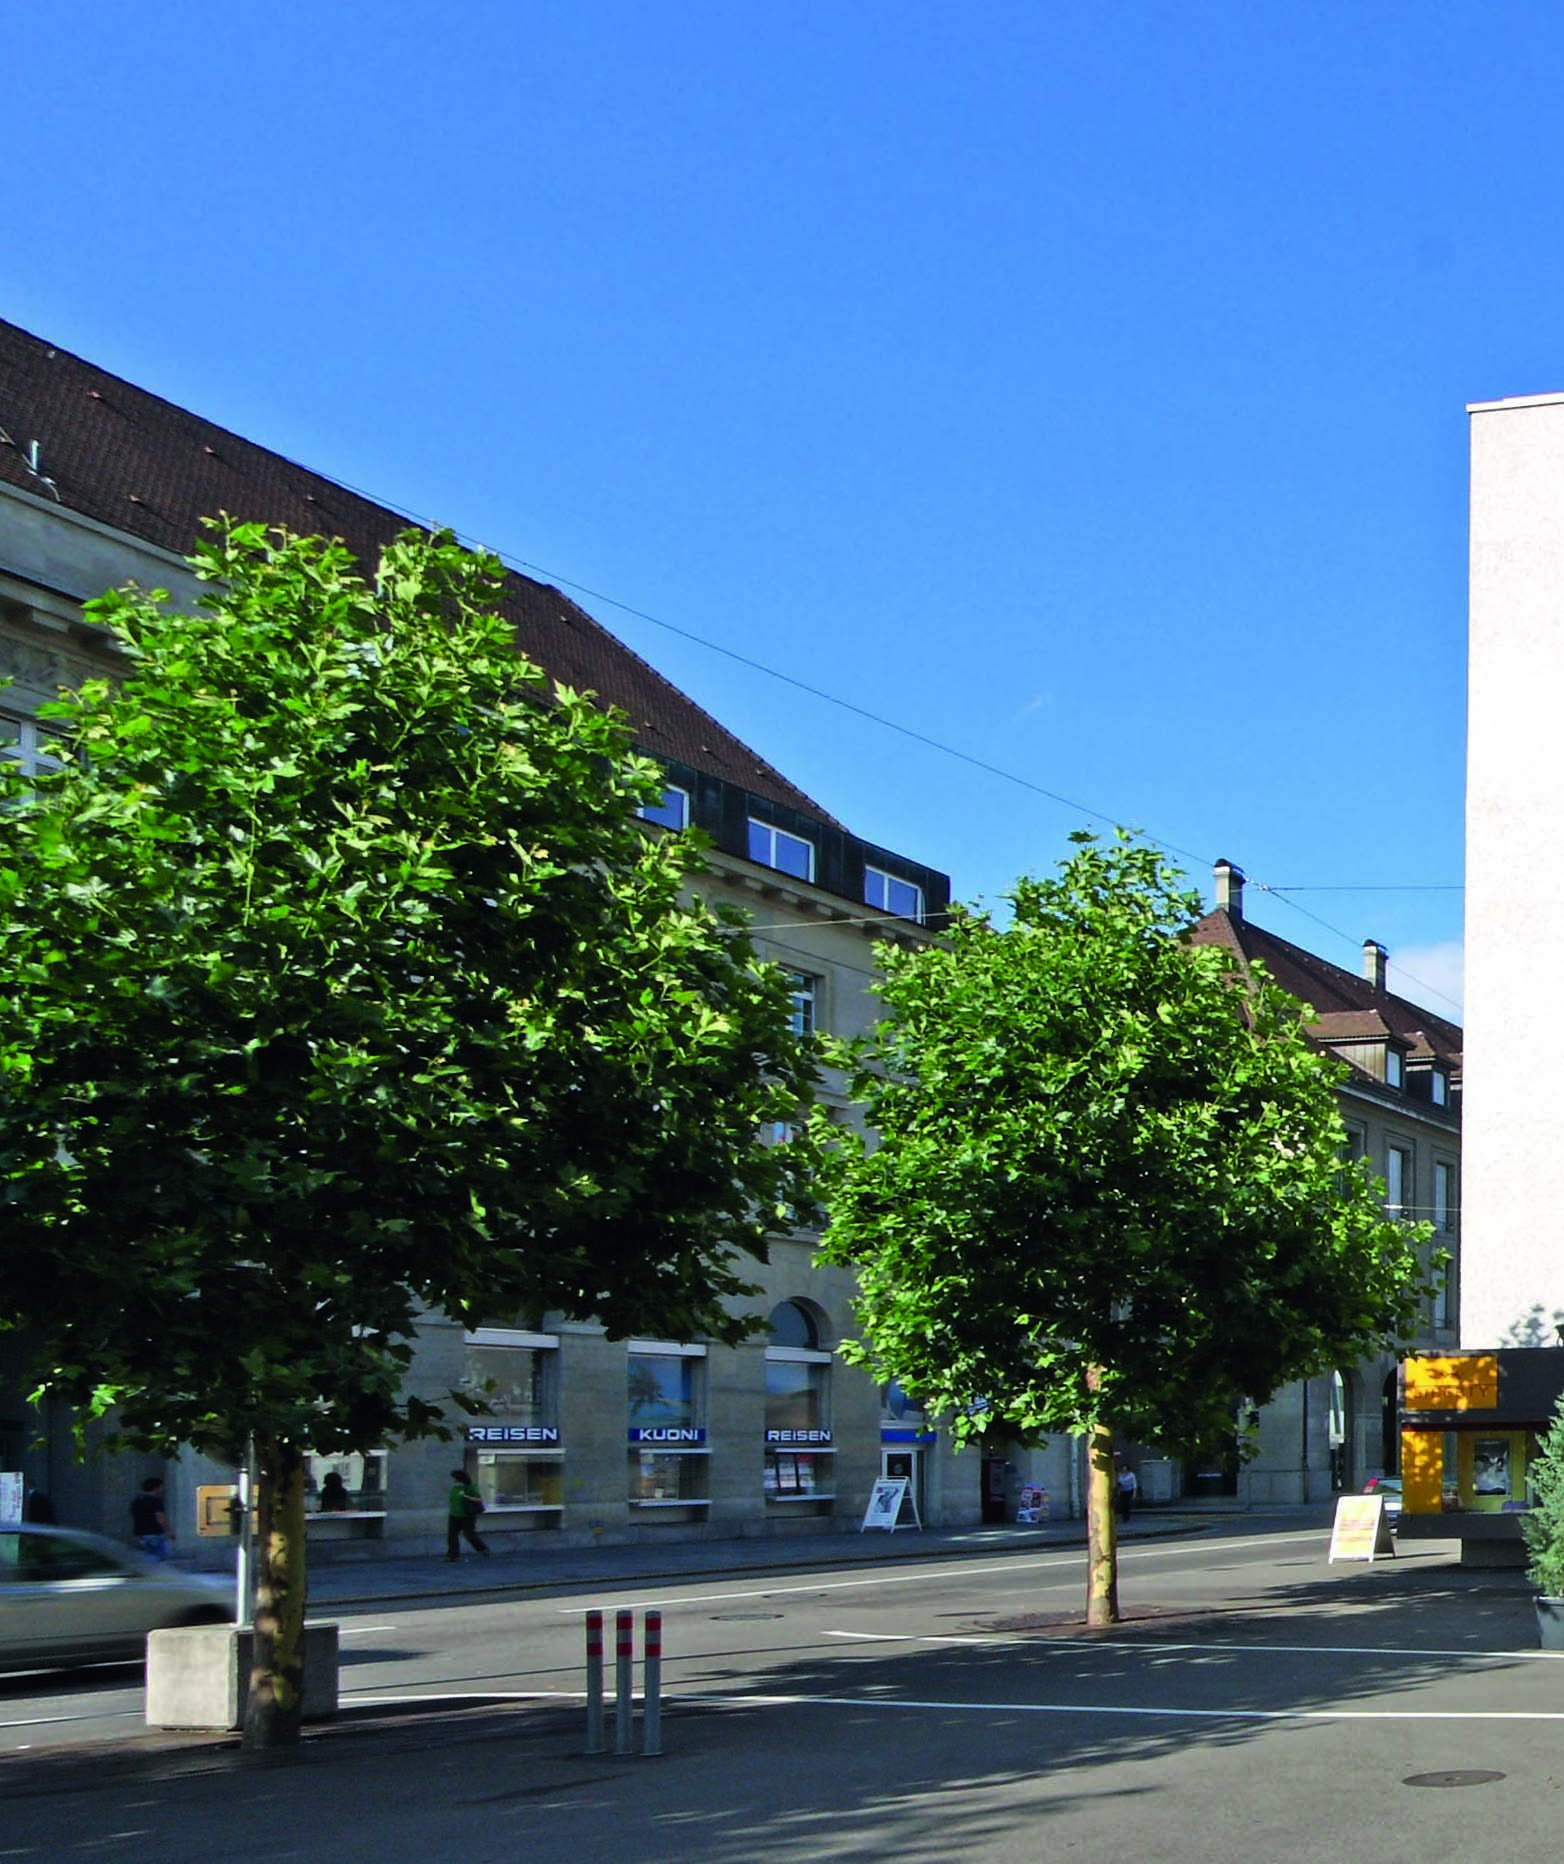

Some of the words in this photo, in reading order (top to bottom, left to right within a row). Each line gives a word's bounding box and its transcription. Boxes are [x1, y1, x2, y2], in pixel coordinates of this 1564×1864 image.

[468, 1427, 557, 1440] REISEN
[639, 1428, 698, 1441] KUONI
[767, 1429, 831, 1441] REISEN
